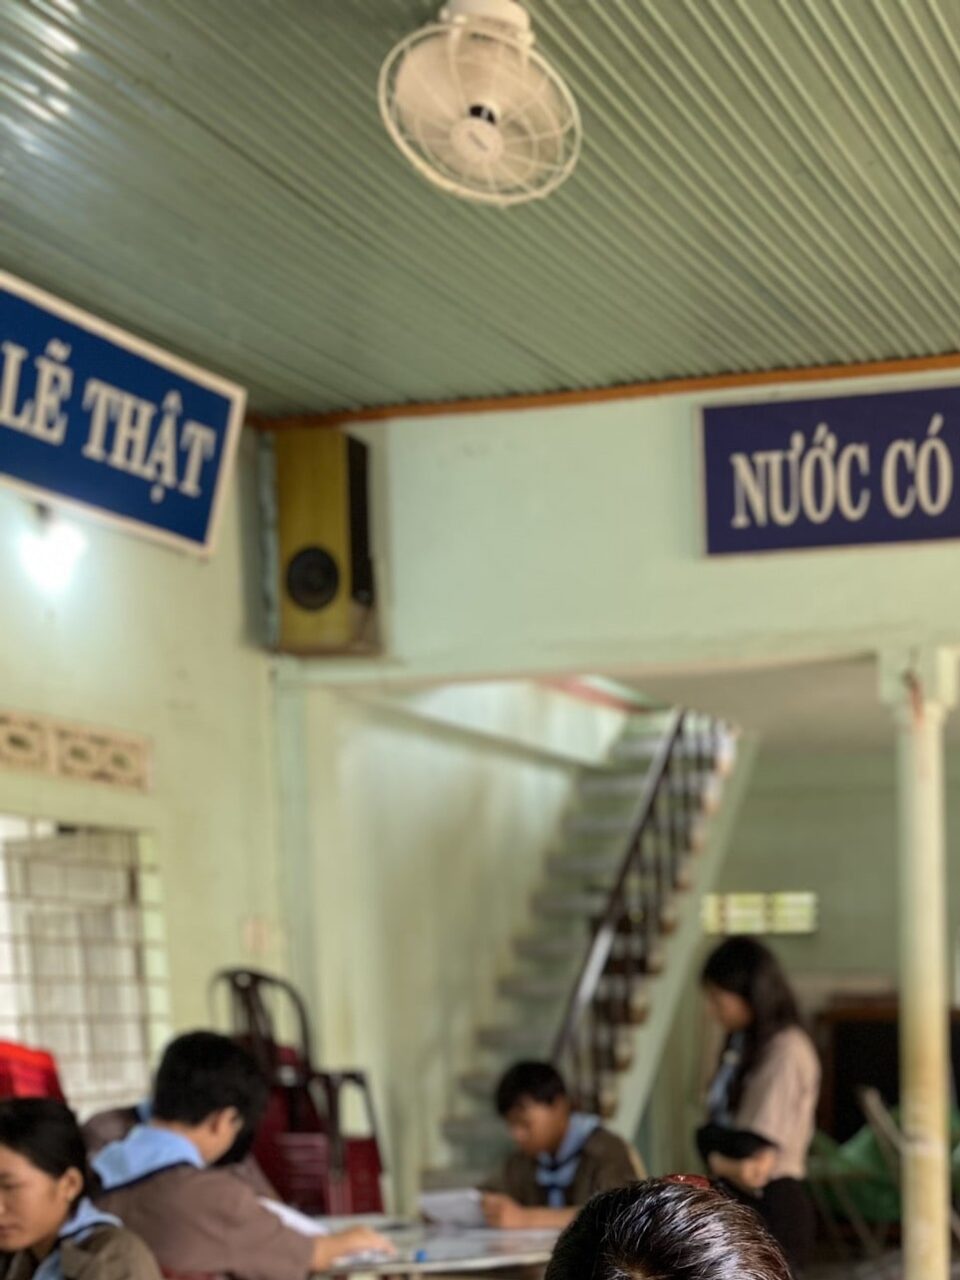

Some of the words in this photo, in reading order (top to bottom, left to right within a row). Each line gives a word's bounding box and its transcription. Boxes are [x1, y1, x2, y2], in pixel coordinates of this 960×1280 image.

[82, 389, 217, 504] THẬT
[730, 422, 870, 528] NƯỚC
[882, 413, 953, 518] CÓ
